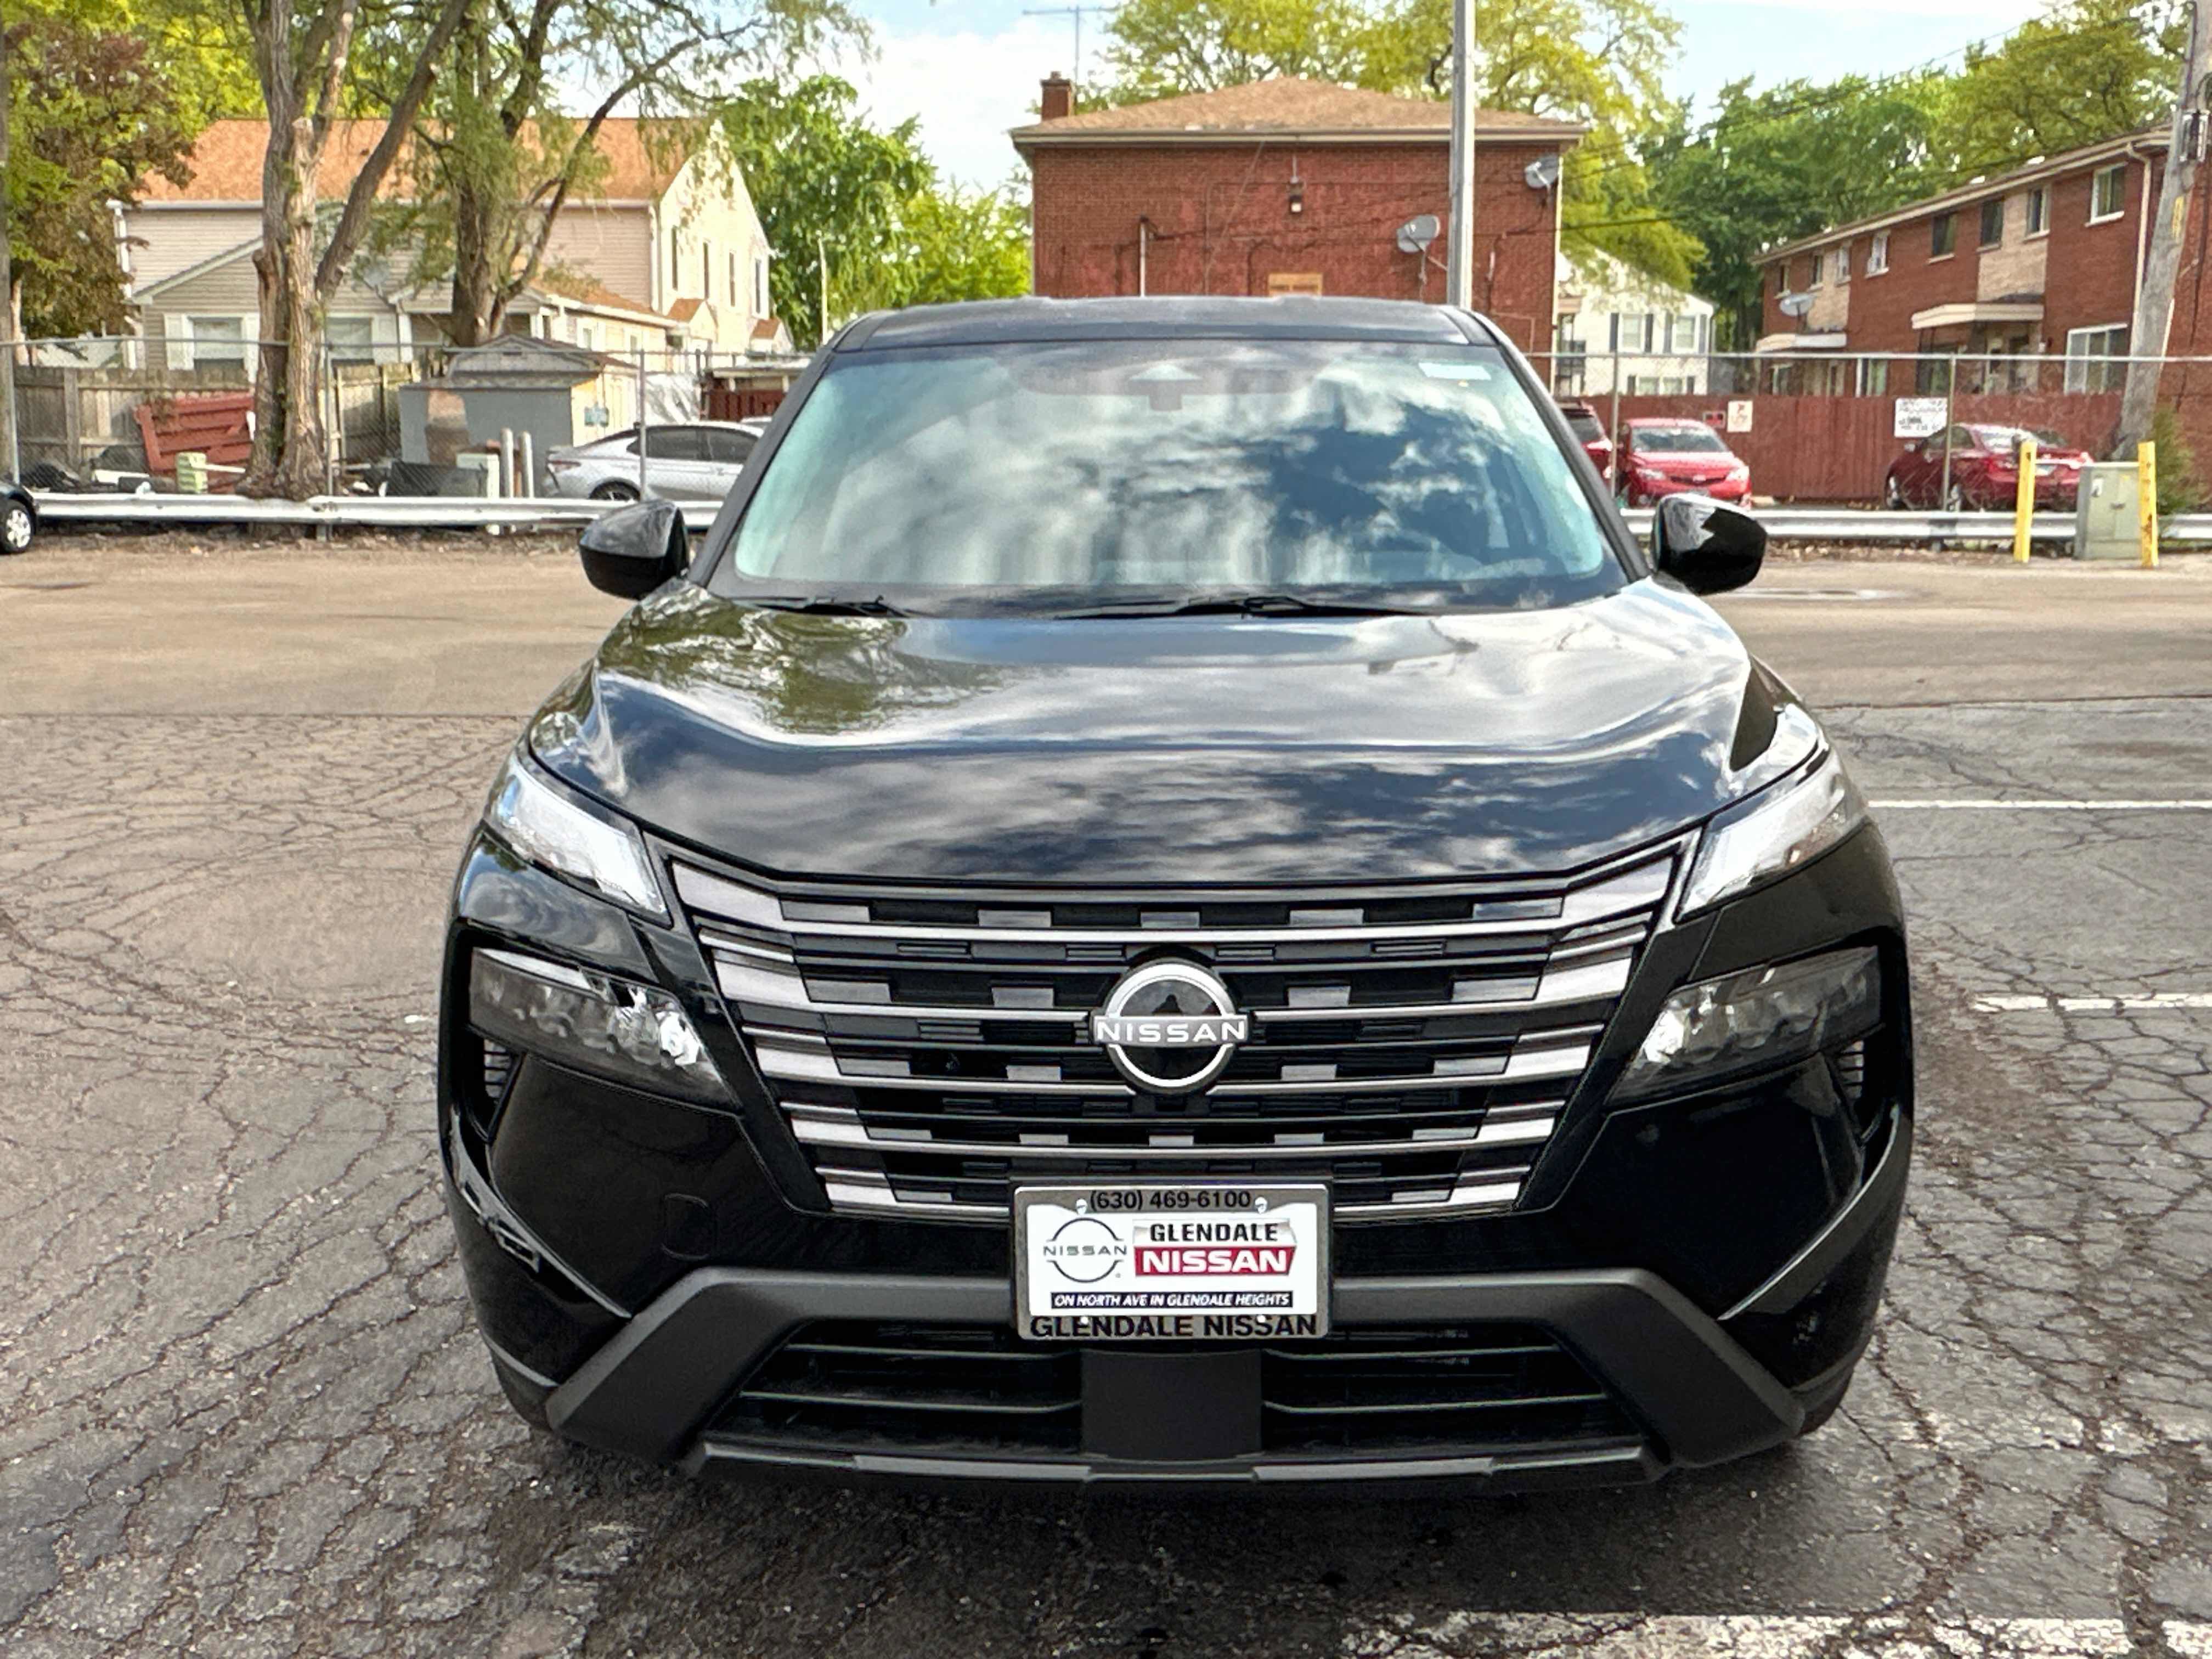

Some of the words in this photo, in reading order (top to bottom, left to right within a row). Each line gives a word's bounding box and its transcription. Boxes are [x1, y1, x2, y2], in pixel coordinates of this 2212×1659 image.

[1097, 1022, 1245, 1042] NISSAN
[1090, 1190, 1142, 1210] (630)
[1149, 1190, 1251, 1209] 469-6100
[1150, 1223, 1278, 1242] GLENDALE
[1043, 1245, 1127, 1257] NISSAN
[1143, 1250, 1287, 1273] NISSAN
[1054, 1294, 1075, 1306] ON
[1076, 1294, 1121, 1306] NORTH
[1122, 1294, 1148, 1306] AVE
[1150, 1294, 1164, 1306] IN
[1167, 1294, 1233, 1306] GLENDALE
[1235, 1294, 1289, 1306] HEIGHTS
[1030, 1316, 1193, 1337] GLENDALE
[1204, 1315, 1317, 1336] NISSAN
